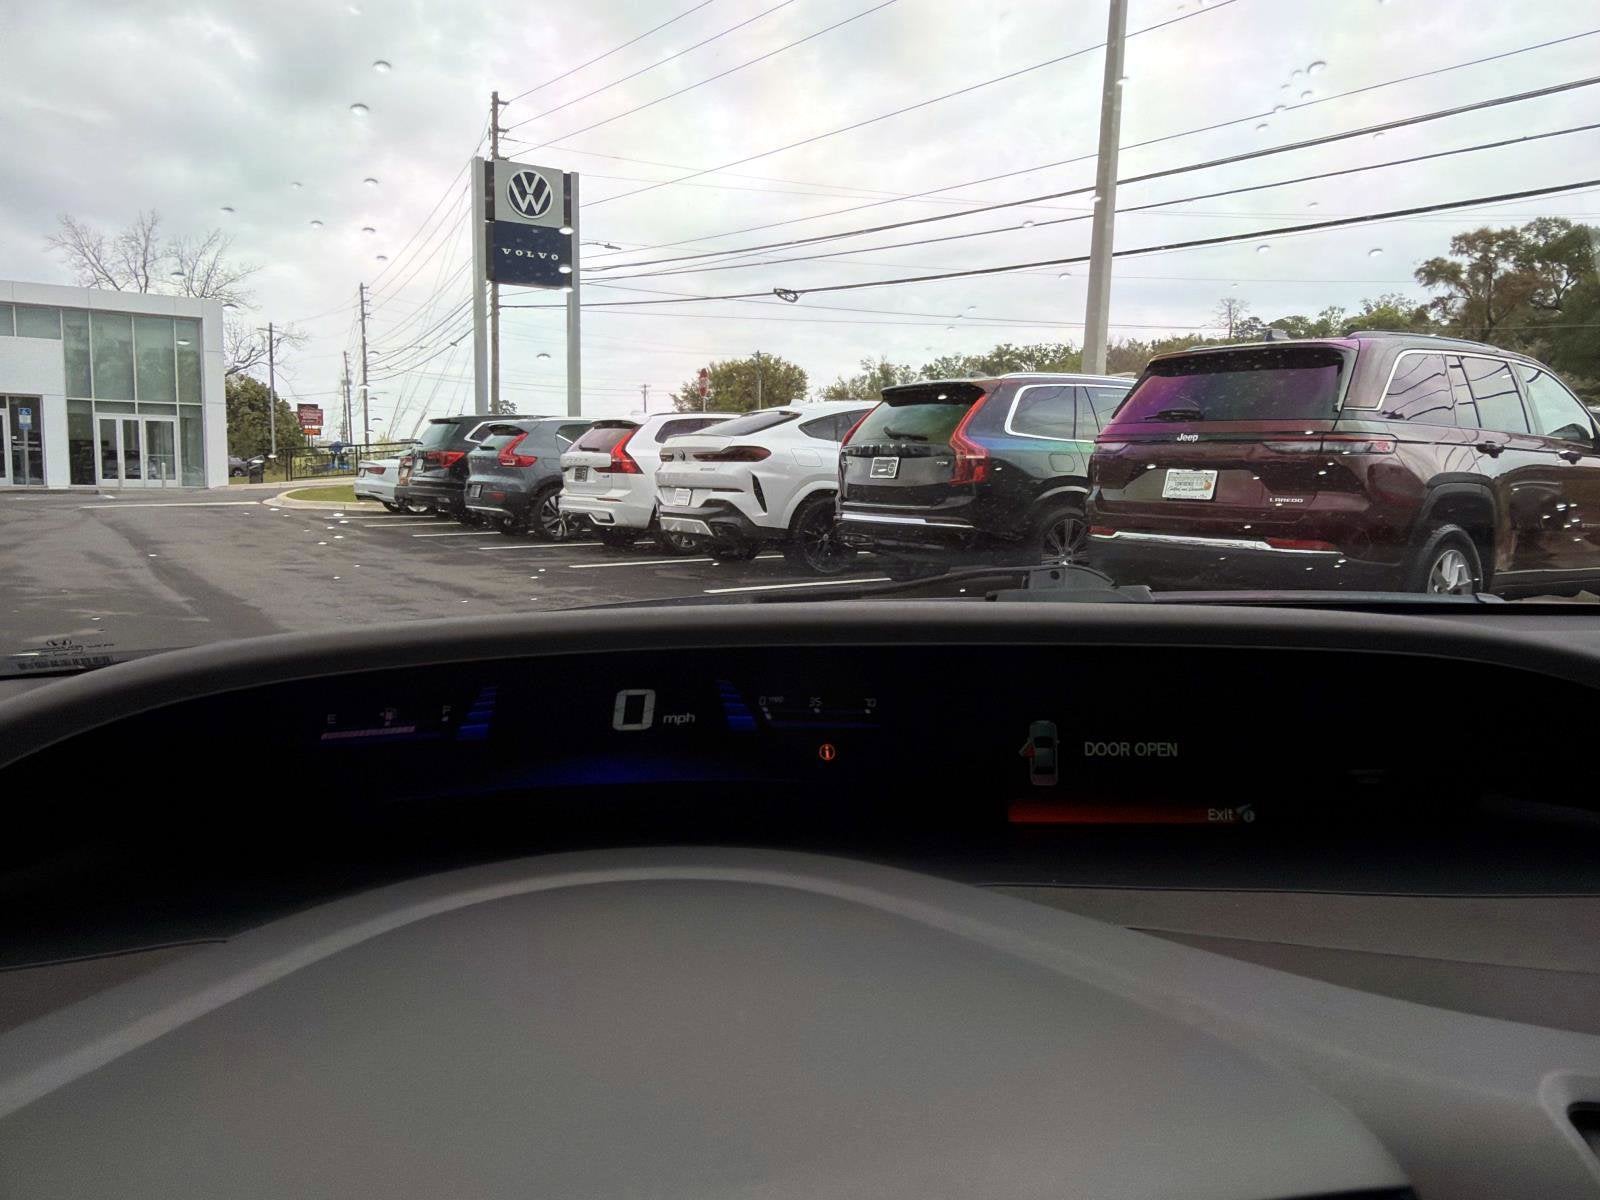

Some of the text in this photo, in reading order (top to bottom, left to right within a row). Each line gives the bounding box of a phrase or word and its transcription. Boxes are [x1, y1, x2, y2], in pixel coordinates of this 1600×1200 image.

[502, 248, 559, 260] VOLVO
[1176, 433, 1199, 443] Jeep
[612, 689, 696, 731] 0 mph
[327, 713, 337, 724] E
[1084, 741, 1178, 757] DOOR OPEN
[1207, 807, 1234, 821] Exit
